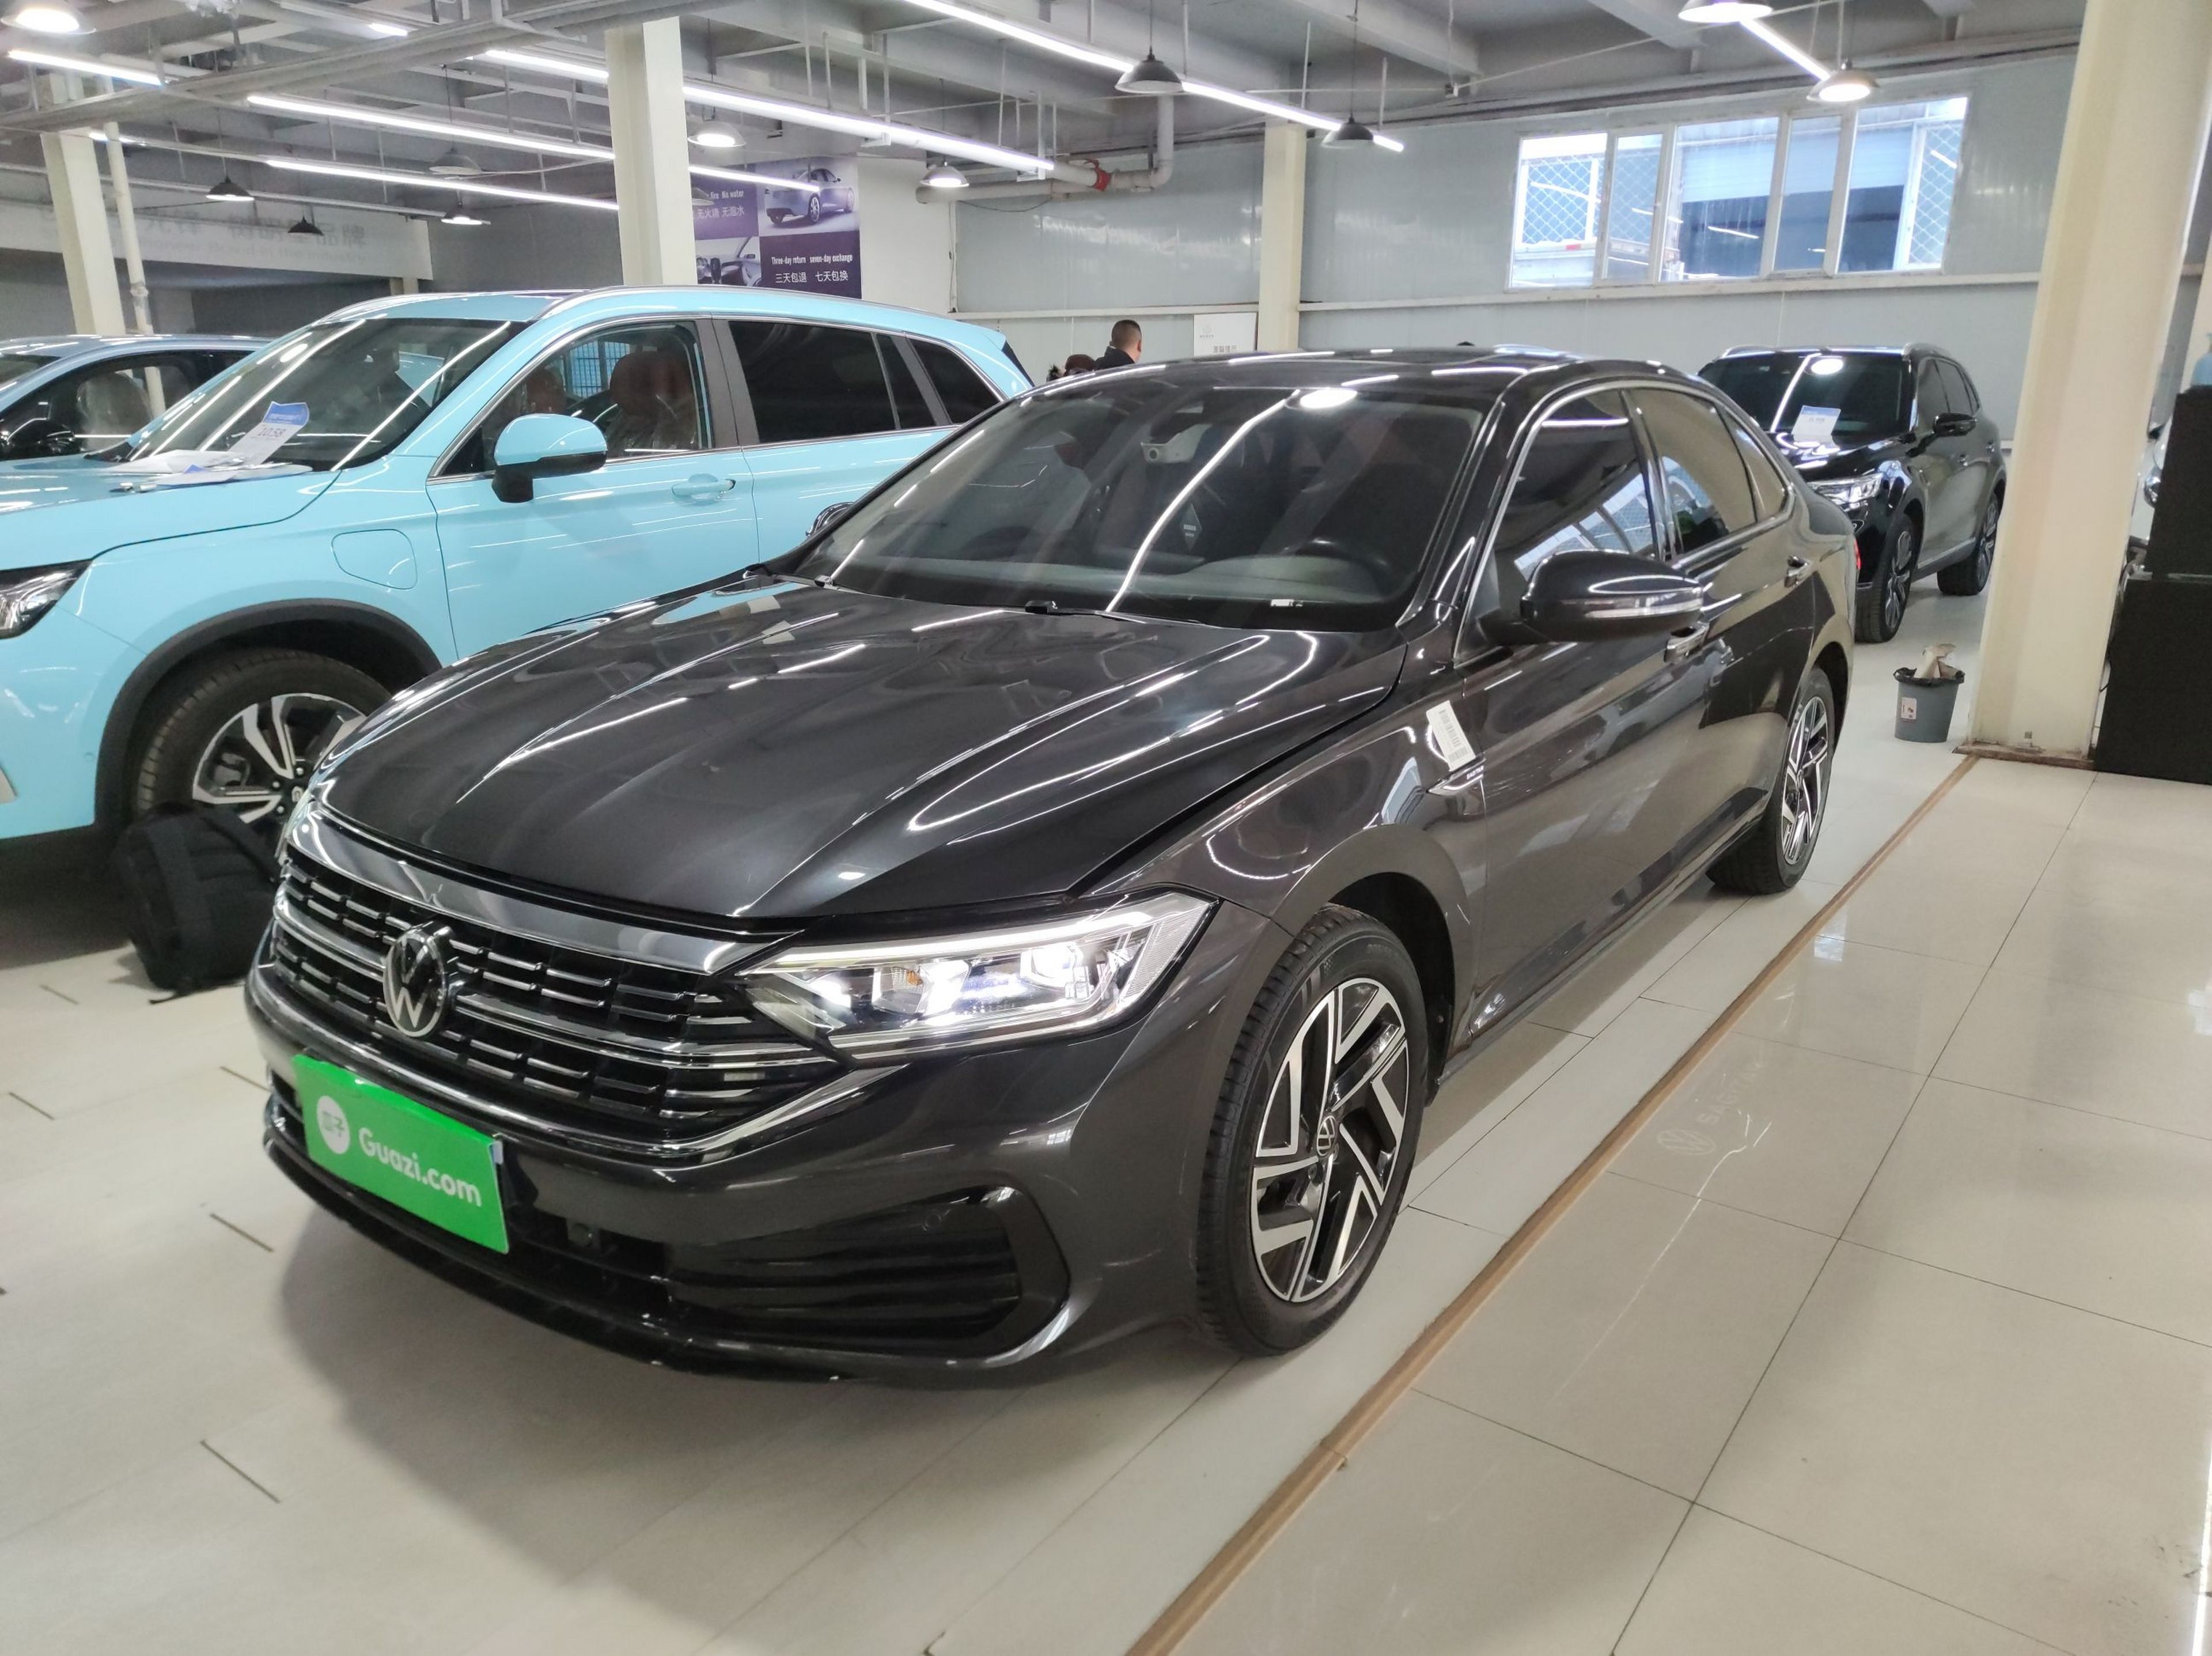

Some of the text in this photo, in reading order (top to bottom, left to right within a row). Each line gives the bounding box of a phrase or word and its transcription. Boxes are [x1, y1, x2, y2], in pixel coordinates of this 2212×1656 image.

[771, 256, 792, 266] Three-day
[793, 256, 806, 264] return
[775, 270, 849, 283] 三天包退 七天包换
[358, 1126, 482, 1208] Guazi.com
